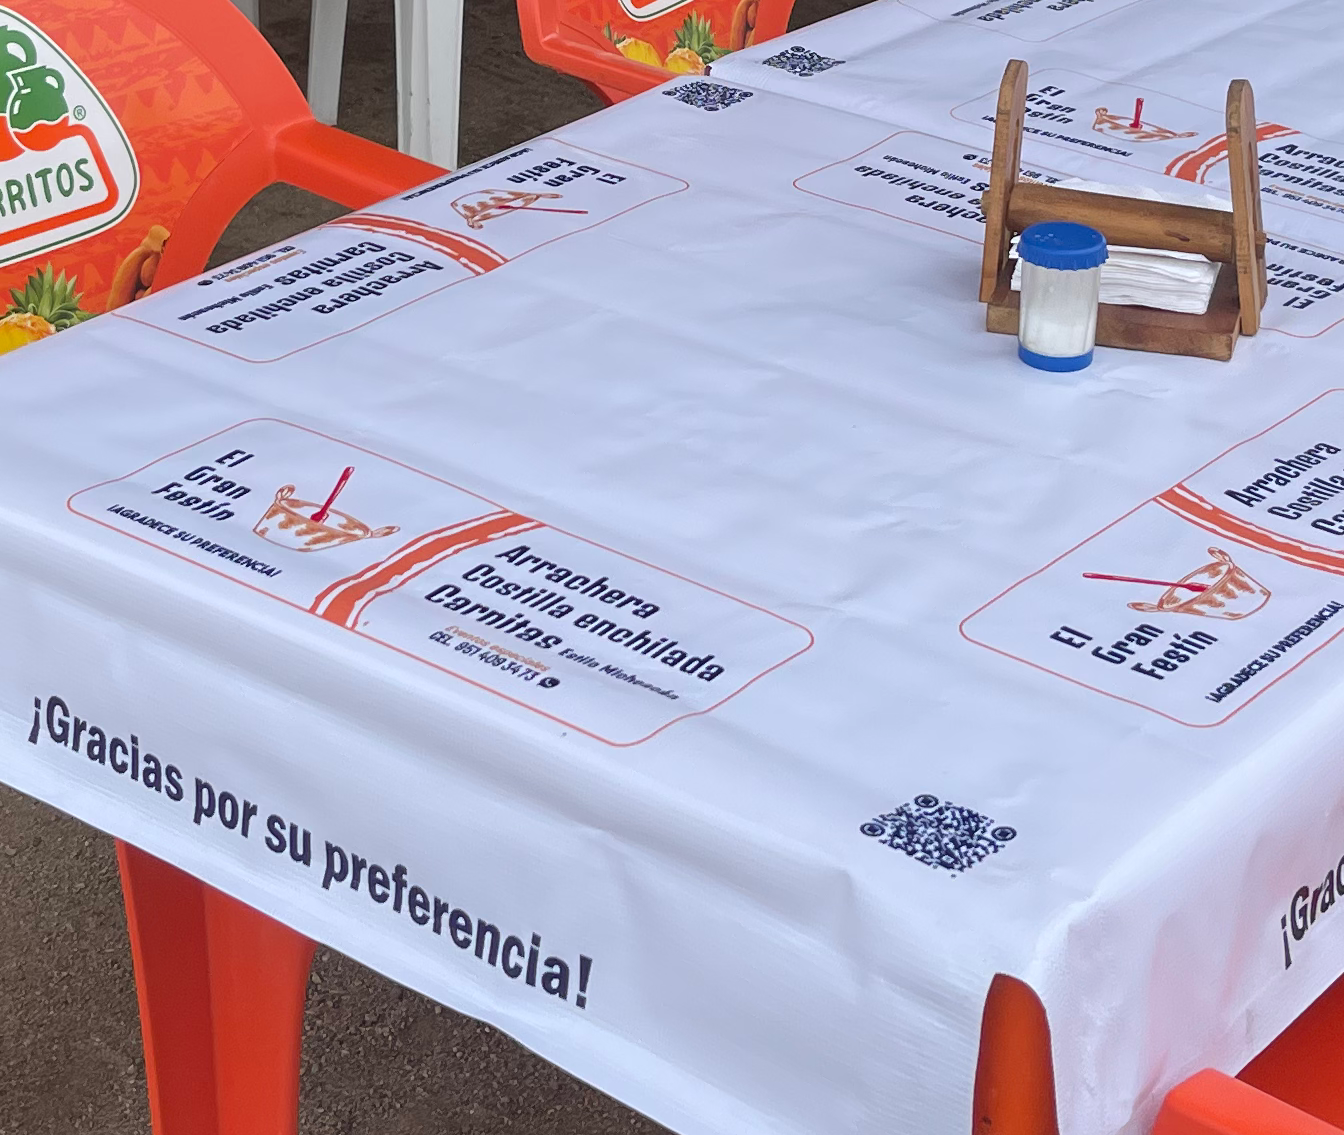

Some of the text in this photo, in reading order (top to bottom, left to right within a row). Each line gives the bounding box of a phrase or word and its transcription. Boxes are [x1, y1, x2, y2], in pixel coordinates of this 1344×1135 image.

[1025, 93, 1077, 114] Gran
[1038, 85, 1066, 97] El
[543, 165, 601, 187] Gran
[596, 173, 627, 185] El
[854, 164, 965, 201] enchilada
[273, 241, 388, 286] Carnitas
[206, 251, 416, 334] Costilla enchilada
[311, 260, 445, 315] Arrachera
[1266, 278, 1332, 299] Gran
[1282, 296, 1315, 309] El
[214, 448, 255, 468] El
[1224, 441, 1342, 508] Arrachera
[152, 481, 235, 522] Festín
[183, 466, 252, 500] Gran
[106, 504, 284, 578] ¡AGRADECE SU PREFERENCIA!
[494, 545, 661, 620] Arrachera
[424, 583, 564, 650] Carnitas
[461, 564, 726, 683] Costilla enchilada
[1050, 625, 1093, 650] El
[1091, 622, 1164, 665] Gran
[1130, 627, 1219, 681] Festín
[27, 694, 594, 1010] ¡Gracias por su preferencia!
